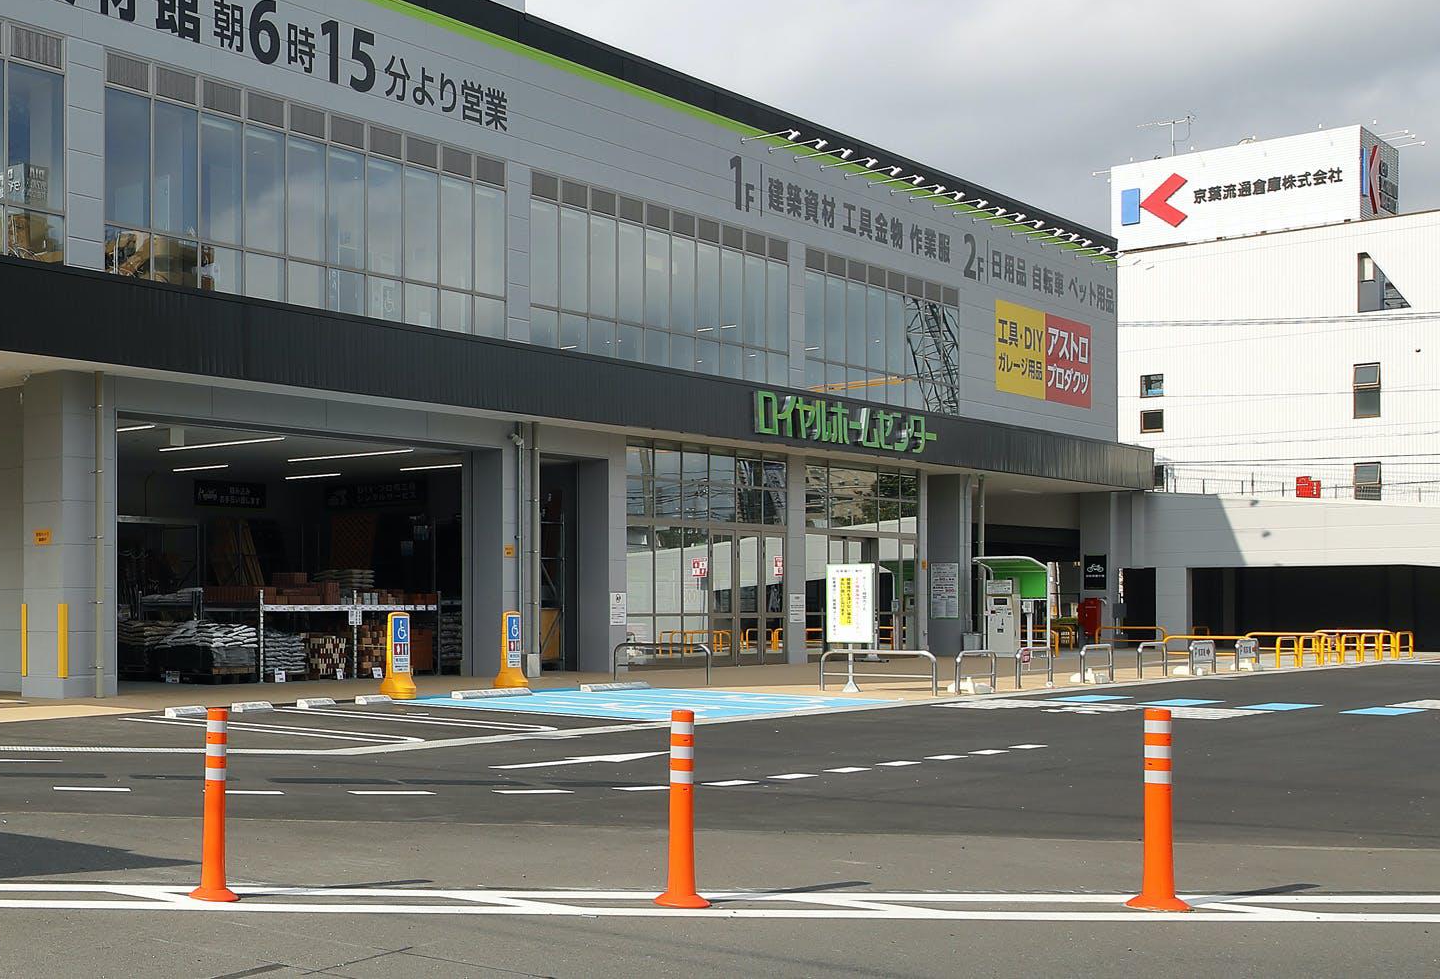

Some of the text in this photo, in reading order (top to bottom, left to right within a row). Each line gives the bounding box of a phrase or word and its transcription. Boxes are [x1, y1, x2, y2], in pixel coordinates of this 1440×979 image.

[768, 177, 836, 228] 建築資材
[842, 202, 904, 250] 工具金物
[909, 223, 951, 264] 作業服
[992, 250, 1027, 287] 日用品
[1032, 264, 1065, 297] 自転車
[1068, 276, 1114, 314] ペット用品
[997, 351, 1043, 382] ガレージ用品
[1047, 324, 1089, 365] アストロ
[1047, 361, 1089, 395] プロダクツ
[753, 390, 938, 454] ロイヤルホームセンター
